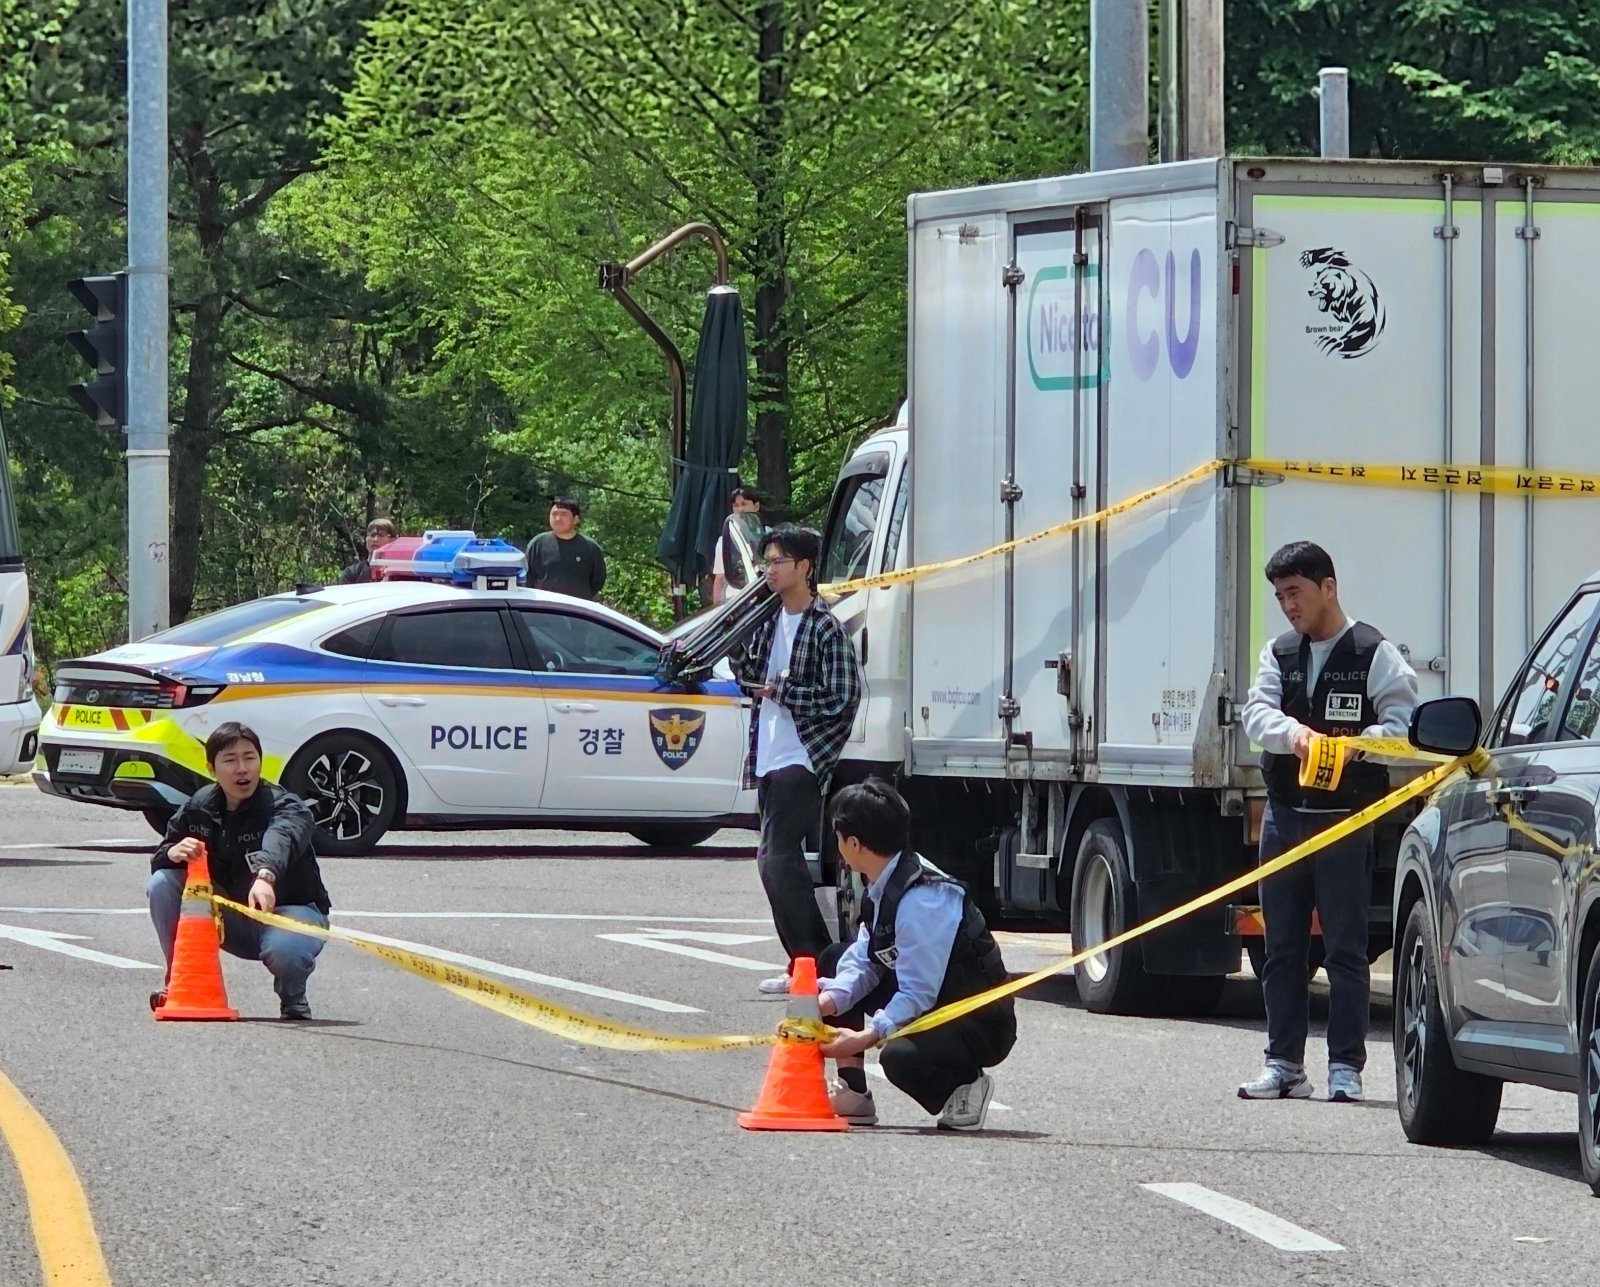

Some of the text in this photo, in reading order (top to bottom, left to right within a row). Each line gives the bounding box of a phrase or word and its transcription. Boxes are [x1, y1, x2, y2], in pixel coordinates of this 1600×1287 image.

[1126, 247, 1201, 383] CU
[1305, 324, 1344, 334] Brown bear
[1401, 466, 1482, 486] 접근금지
[1516, 473, 1596, 493] 접근금지
[1282, 670, 1305, 681] LICE
[1324, 671, 1367, 681] POLICE
[75, 709, 102, 725] POLICE
[1328, 710, 1358, 718] DETECTIVE
[431, 725, 528, 750] POLICE
[1332, 727, 1361, 737] POLI
[579, 727, 625, 756] 경찰
[662, 750, 688, 759] POLICE
